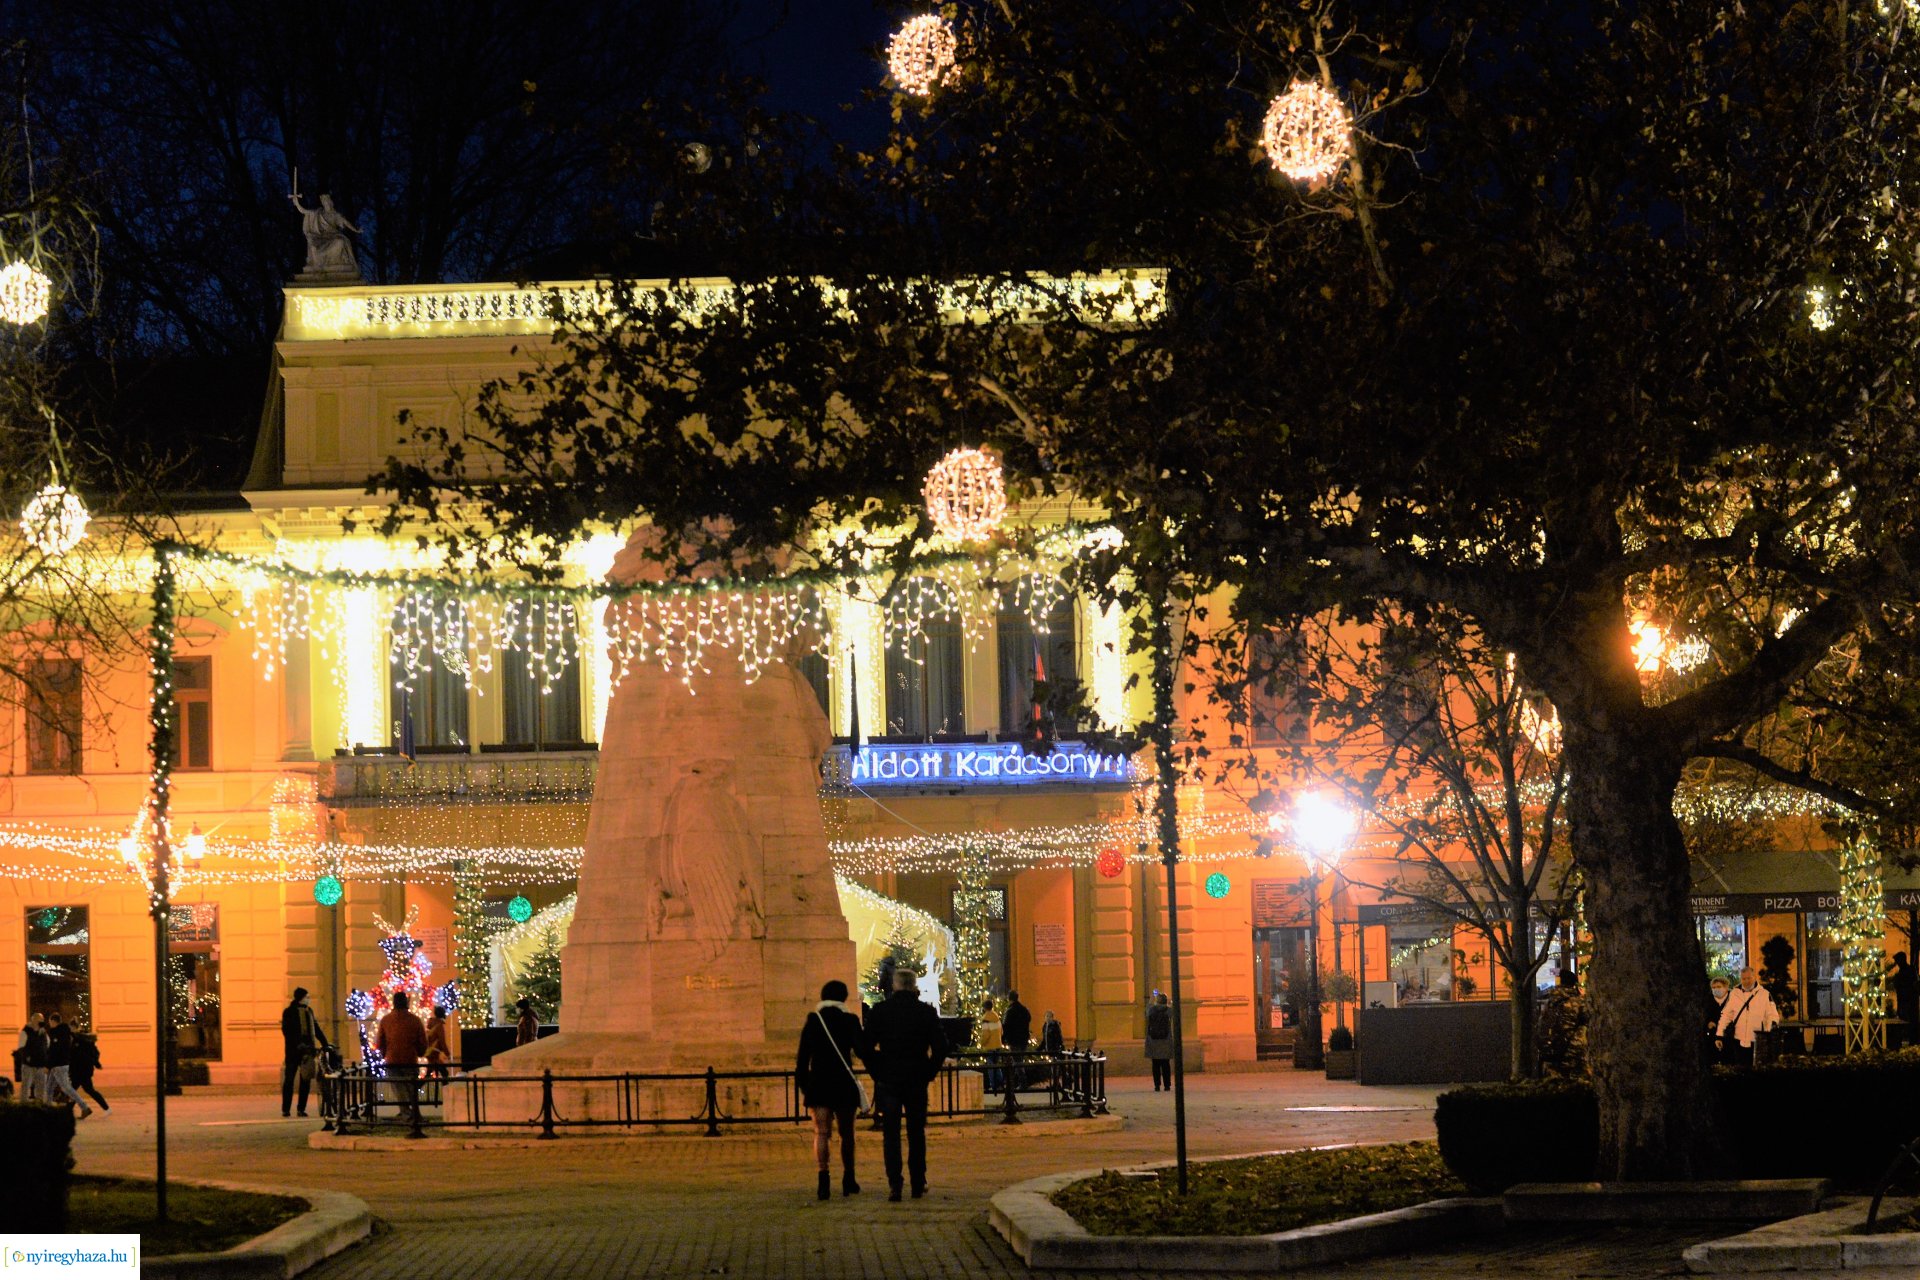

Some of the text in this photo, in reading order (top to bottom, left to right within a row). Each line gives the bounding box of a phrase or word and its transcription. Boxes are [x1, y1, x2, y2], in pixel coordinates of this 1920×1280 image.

[851, 747, 942, 779] Áldott
[1690, 897, 1726, 906] NTINENT
[1764, 897, 1802, 910] PIZZA
[1456, 907, 1494, 919] PIZA
